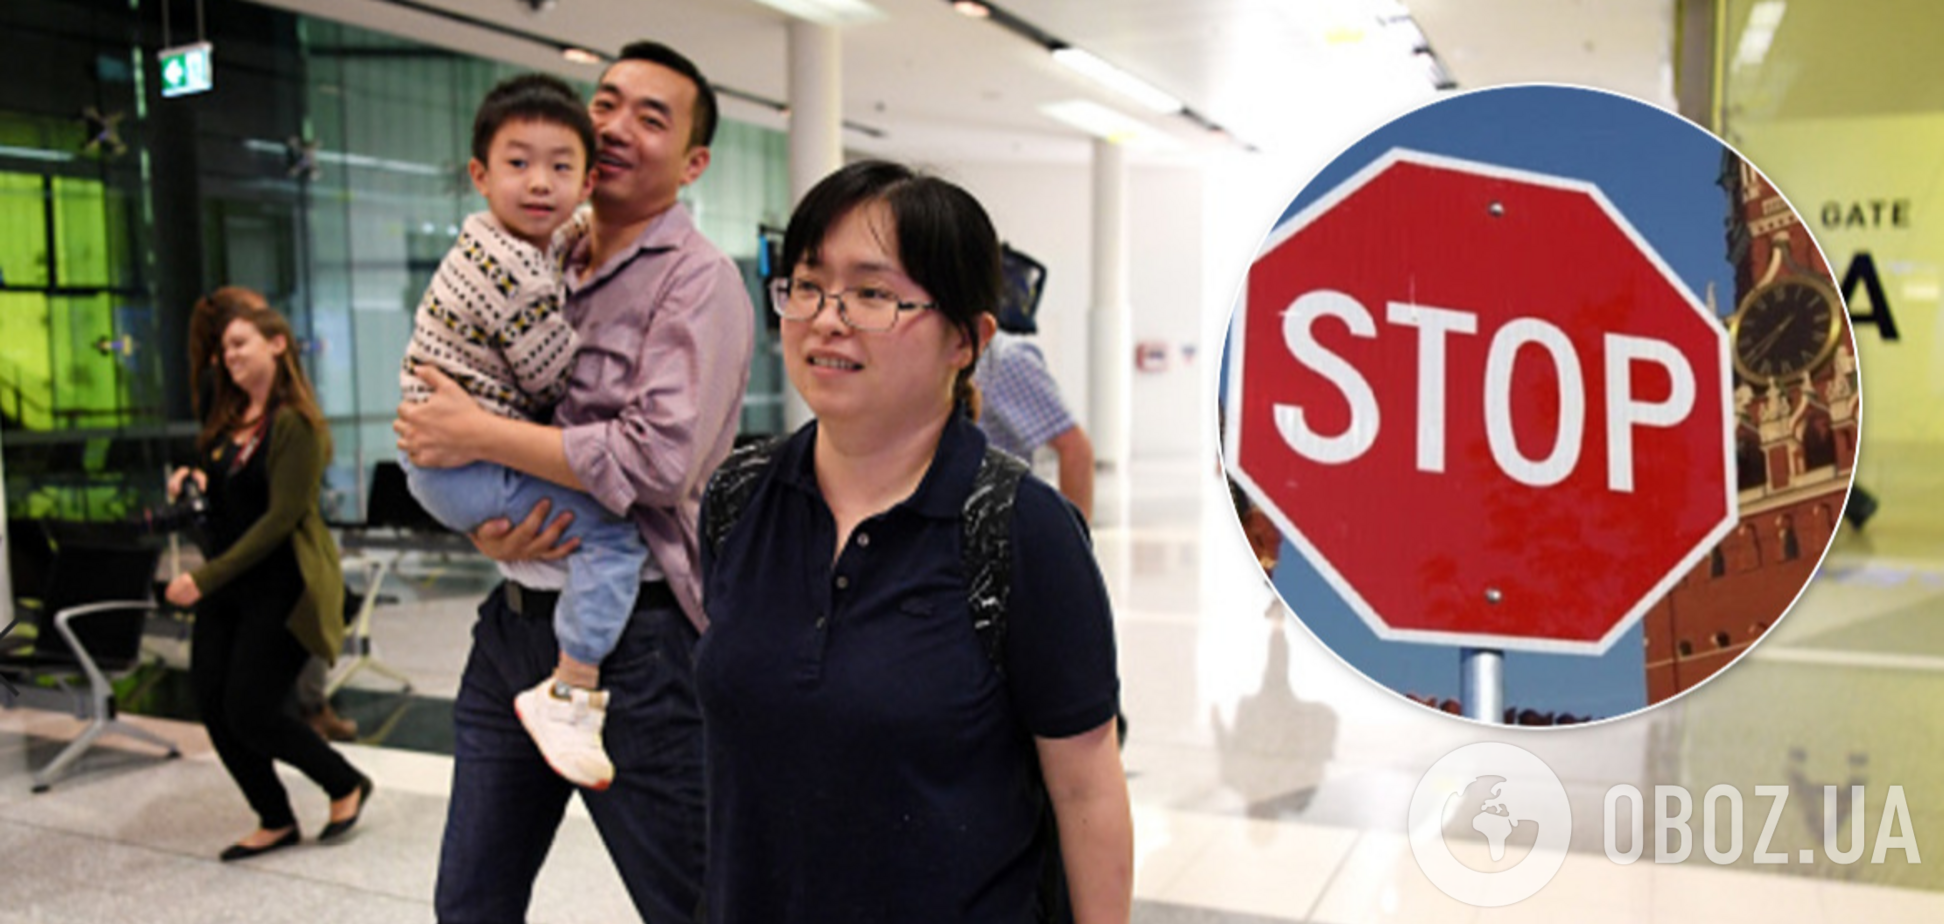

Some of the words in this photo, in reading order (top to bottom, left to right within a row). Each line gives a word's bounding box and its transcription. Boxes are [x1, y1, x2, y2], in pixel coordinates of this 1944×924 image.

[1821, 199, 1911, 229] GATE
[1841, 252, 1900, 341] A
[1273, 289, 1696, 493] STOP
